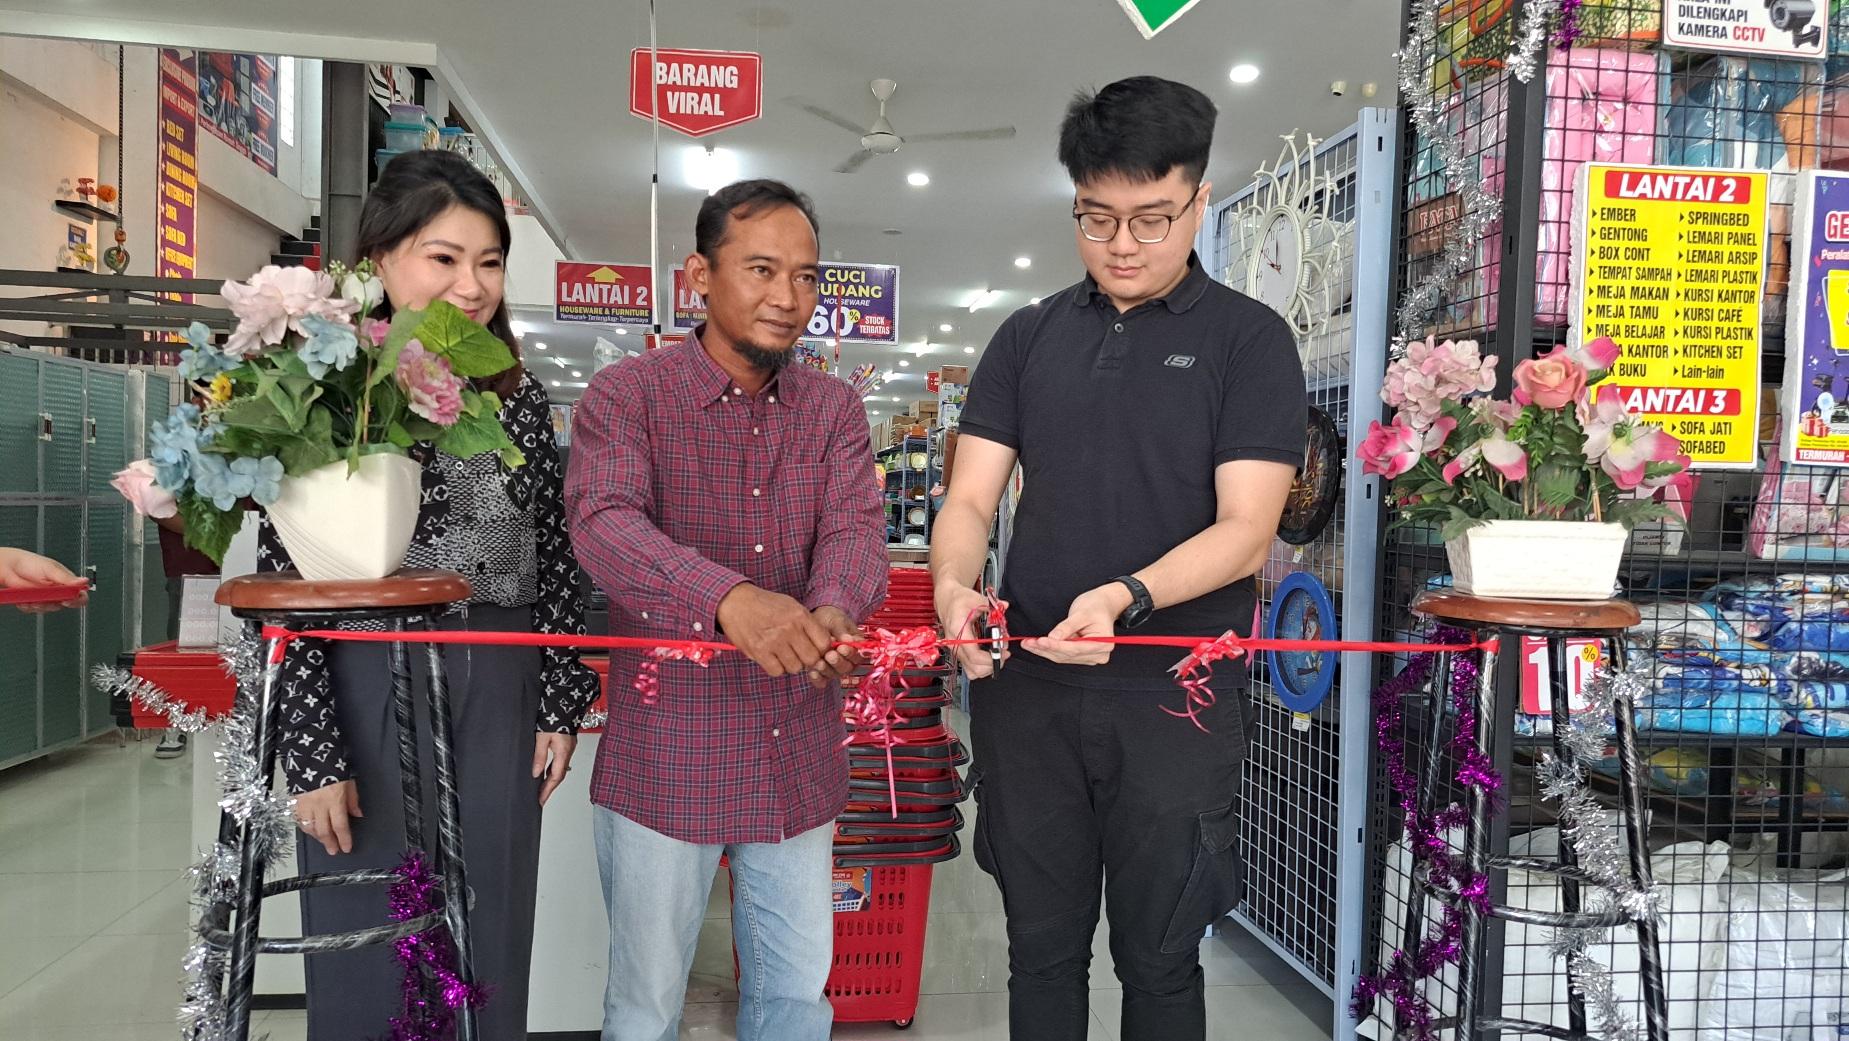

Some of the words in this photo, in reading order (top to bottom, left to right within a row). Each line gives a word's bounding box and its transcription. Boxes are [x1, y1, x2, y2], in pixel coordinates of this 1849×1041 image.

[1678, 5, 1748, 23] DILENGKAPI
[1678, 22, 1728, 39] KAMERA
[1733, 26, 1765, 42] CCTV
[656, 62, 738, 88] BARANG
[667, 91, 724, 116] VIRAL
[1619, 173, 1715, 201] LANTAI
[1719, 178, 1736, 202] 2
[1600, 207, 1636, 222] EMBER
[1688, 211, 1750, 227] SPRINGBED
[1600, 227, 1648, 242] GENTONG
[1687, 231, 1723, 245] LEMARI
[1727, 232, 1757, 247] PANEL
[1598, 246, 1620, 261] BOX
[1624, 247, 1651, 261] CONT
[1686, 250, 1724, 264] LEMARI
[1727, 251, 1758, 266] ARSIP
[825, 269, 866, 283] CUCI
[1598, 266, 1632, 280] TEMPAT
[1635, 267, 1672, 282] SAMPAH
[1685, 269, 1718, 283] LEMARI
[1722, 270, 1758, 285] PLASTIK
[561, 282, 629, 305] LANTAI
[636, 286, 648, 306] 2
[1597, 285, 1625, 300] MEJA
[1630, 286, 1669, 301] MAKAN
[1684, 288, 1714, 302] KURSI
[1717, 289, 1755, 304] KANTOR
[560, 305, 603, 315] HOUSEWARE
[611, 309, 649, 317] FURNITURE
[1596, 304, 1625, 319] MEJA
[1629, 305, 1658, 319] TAMU
[1683, 308, 1713, 322] KURSI
[865, 315, 885, 325] STOCK
[860, 325, 890, 334] TERBATAS
[1595, 324, 1621, 338] MEJA
[1625, 325, 1665, 339] BELAJAR
[1683, 325, 1711, 340] KURSI
[1715, 326, 1754, 341] PLASTIK
[1627, 344, 1669, 358] KANTOR
[1682, 345, 1723, 359] KITCHEN
[1726, 346, 1743, 359] SET
[1619, 364, 1646, 377] BUKU
[1682, 365, 1724, 379] Lain-lain
[1617, 389, 1706, 414] ANTAI
[1709, 390, 1727, 413] 3
[1680, 421, 1705, 435] SOFA
[1709, 422, 1732, 435] JATI
[1679, 440, 1726, 454] SOFABED
